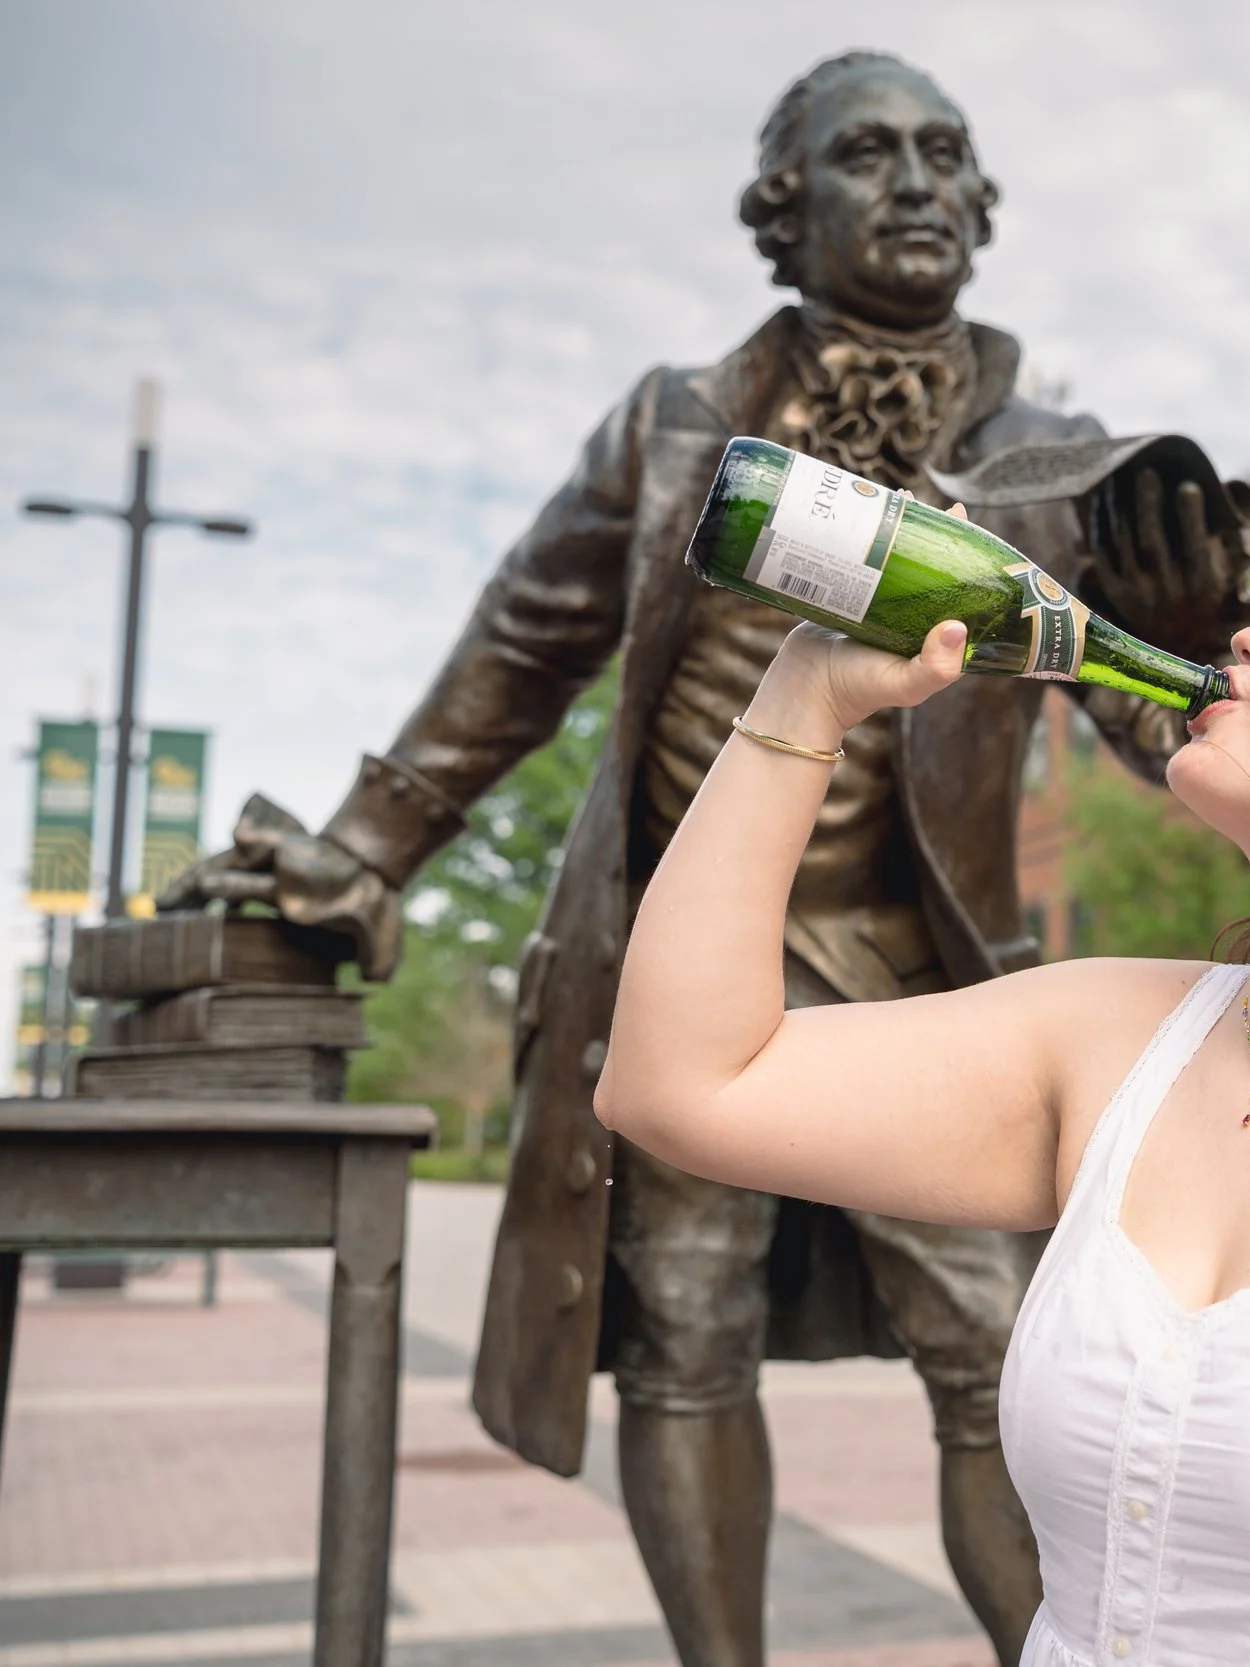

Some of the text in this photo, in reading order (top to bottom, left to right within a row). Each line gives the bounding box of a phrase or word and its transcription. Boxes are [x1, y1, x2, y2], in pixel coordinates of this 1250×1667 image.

[811, 467, 843, 520] DRÉ
[887, 506, 898, 525] DRY
[1054, 615, 1062, 650] EXTRA
[1051, 653, 1060, 669] DRY
